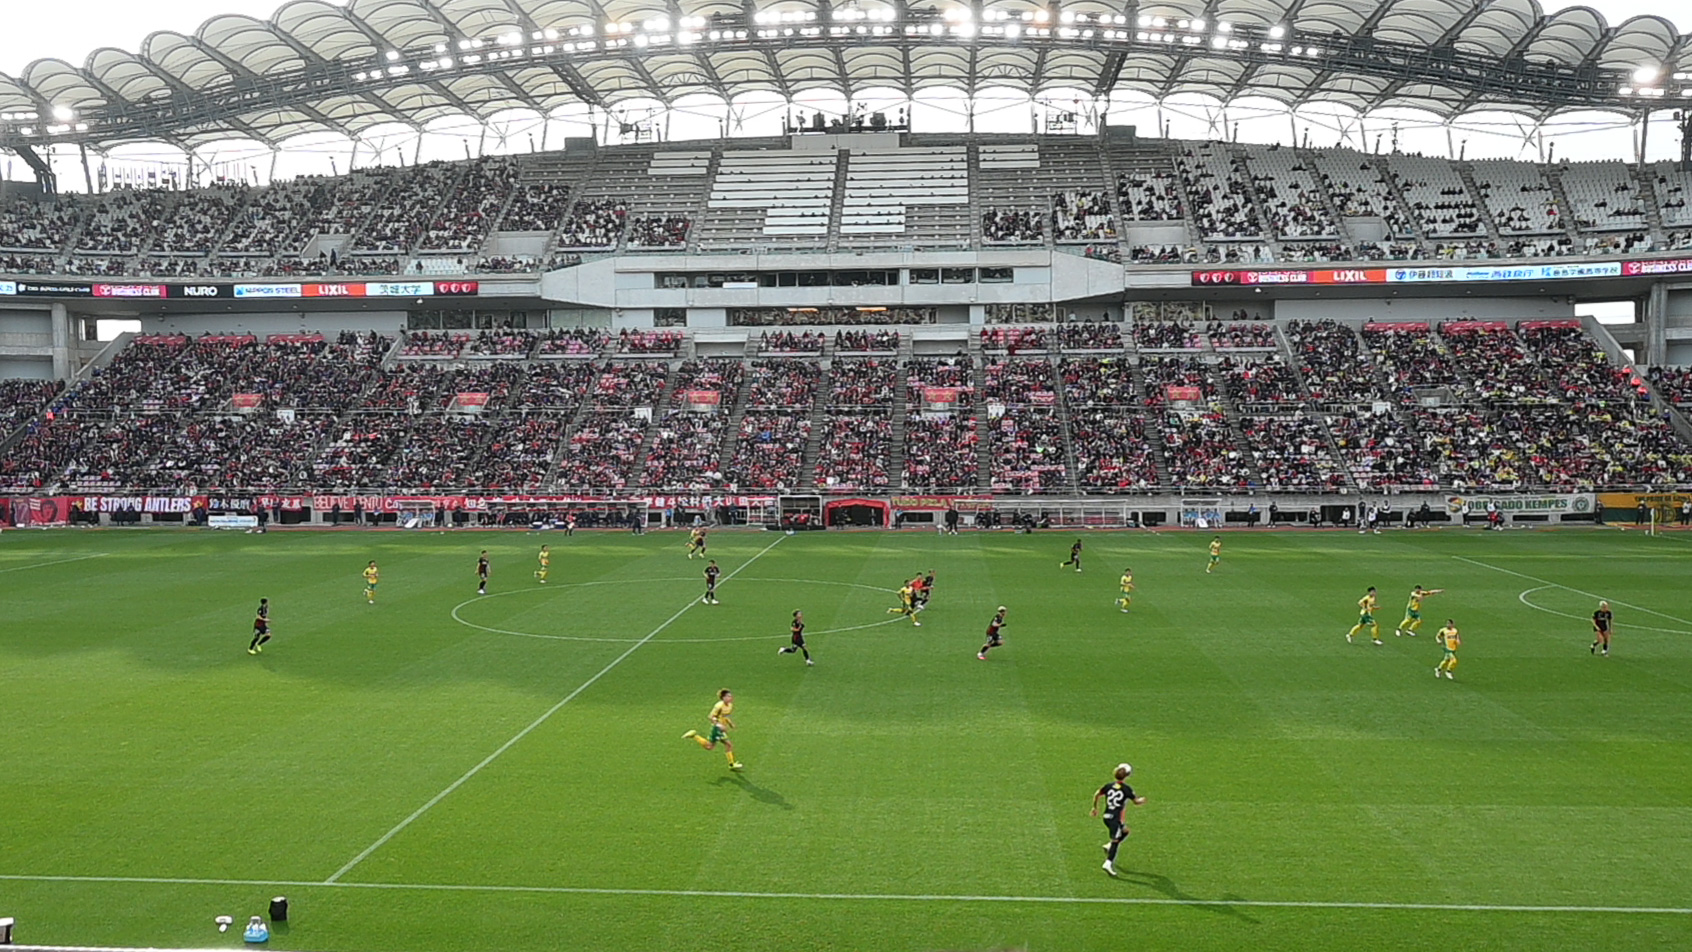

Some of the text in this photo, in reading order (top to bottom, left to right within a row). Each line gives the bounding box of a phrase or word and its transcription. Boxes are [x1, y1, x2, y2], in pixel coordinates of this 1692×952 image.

[1333, 269, 1367, 281] LIXIL
[183, 286, 218, 296] NURO
[275, 287, 300, 295] STEEL
[318, 284, 348, 295] LIXIL
[84, 497, 192, 512] BE STRONG ANTLERS
[1468, 499, 1568, 511] OBRGADO KEMPES
[1107, 789, 1124, 806] 22
